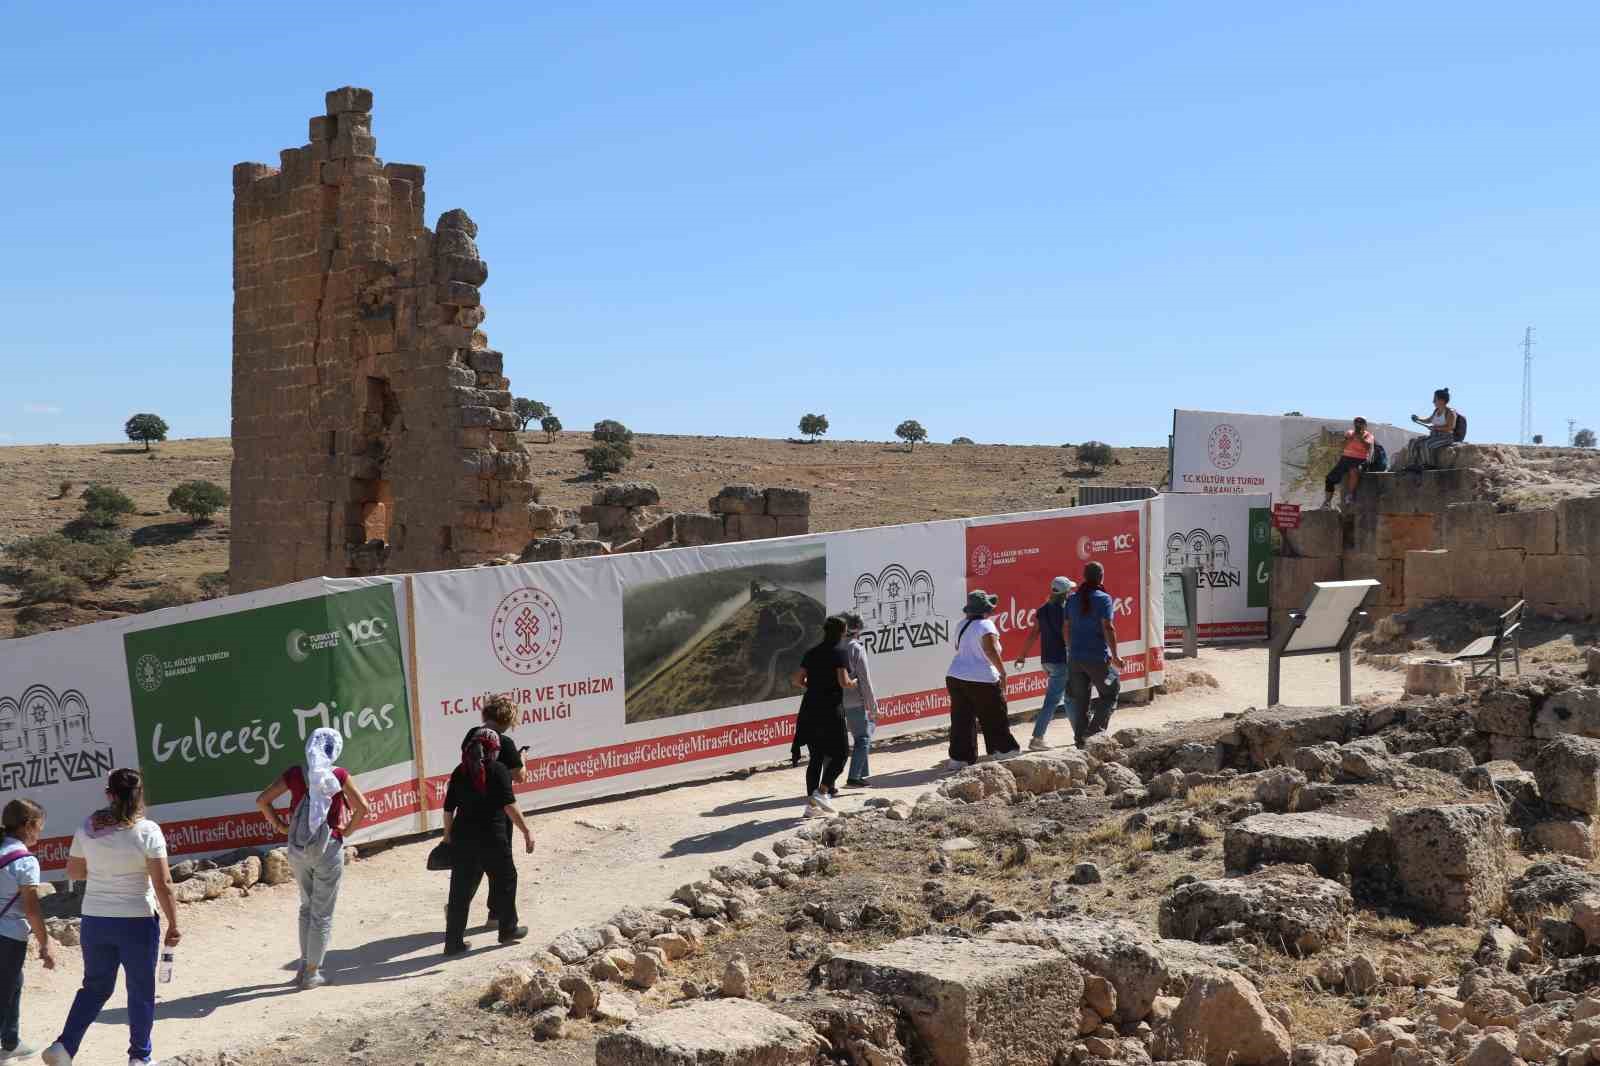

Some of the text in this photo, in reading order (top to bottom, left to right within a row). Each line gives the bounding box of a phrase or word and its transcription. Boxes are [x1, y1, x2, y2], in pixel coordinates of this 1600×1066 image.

[1227, 475, 1238, 485] VE
[440, 698, 468, 717] T.C.
[535, 686, 554, 702] VE
[558, 676, 614, 699] TURİZM
[521, 703, 572, 725] ANLIĞI
[152, 716, 285, 766] Geleceğe
